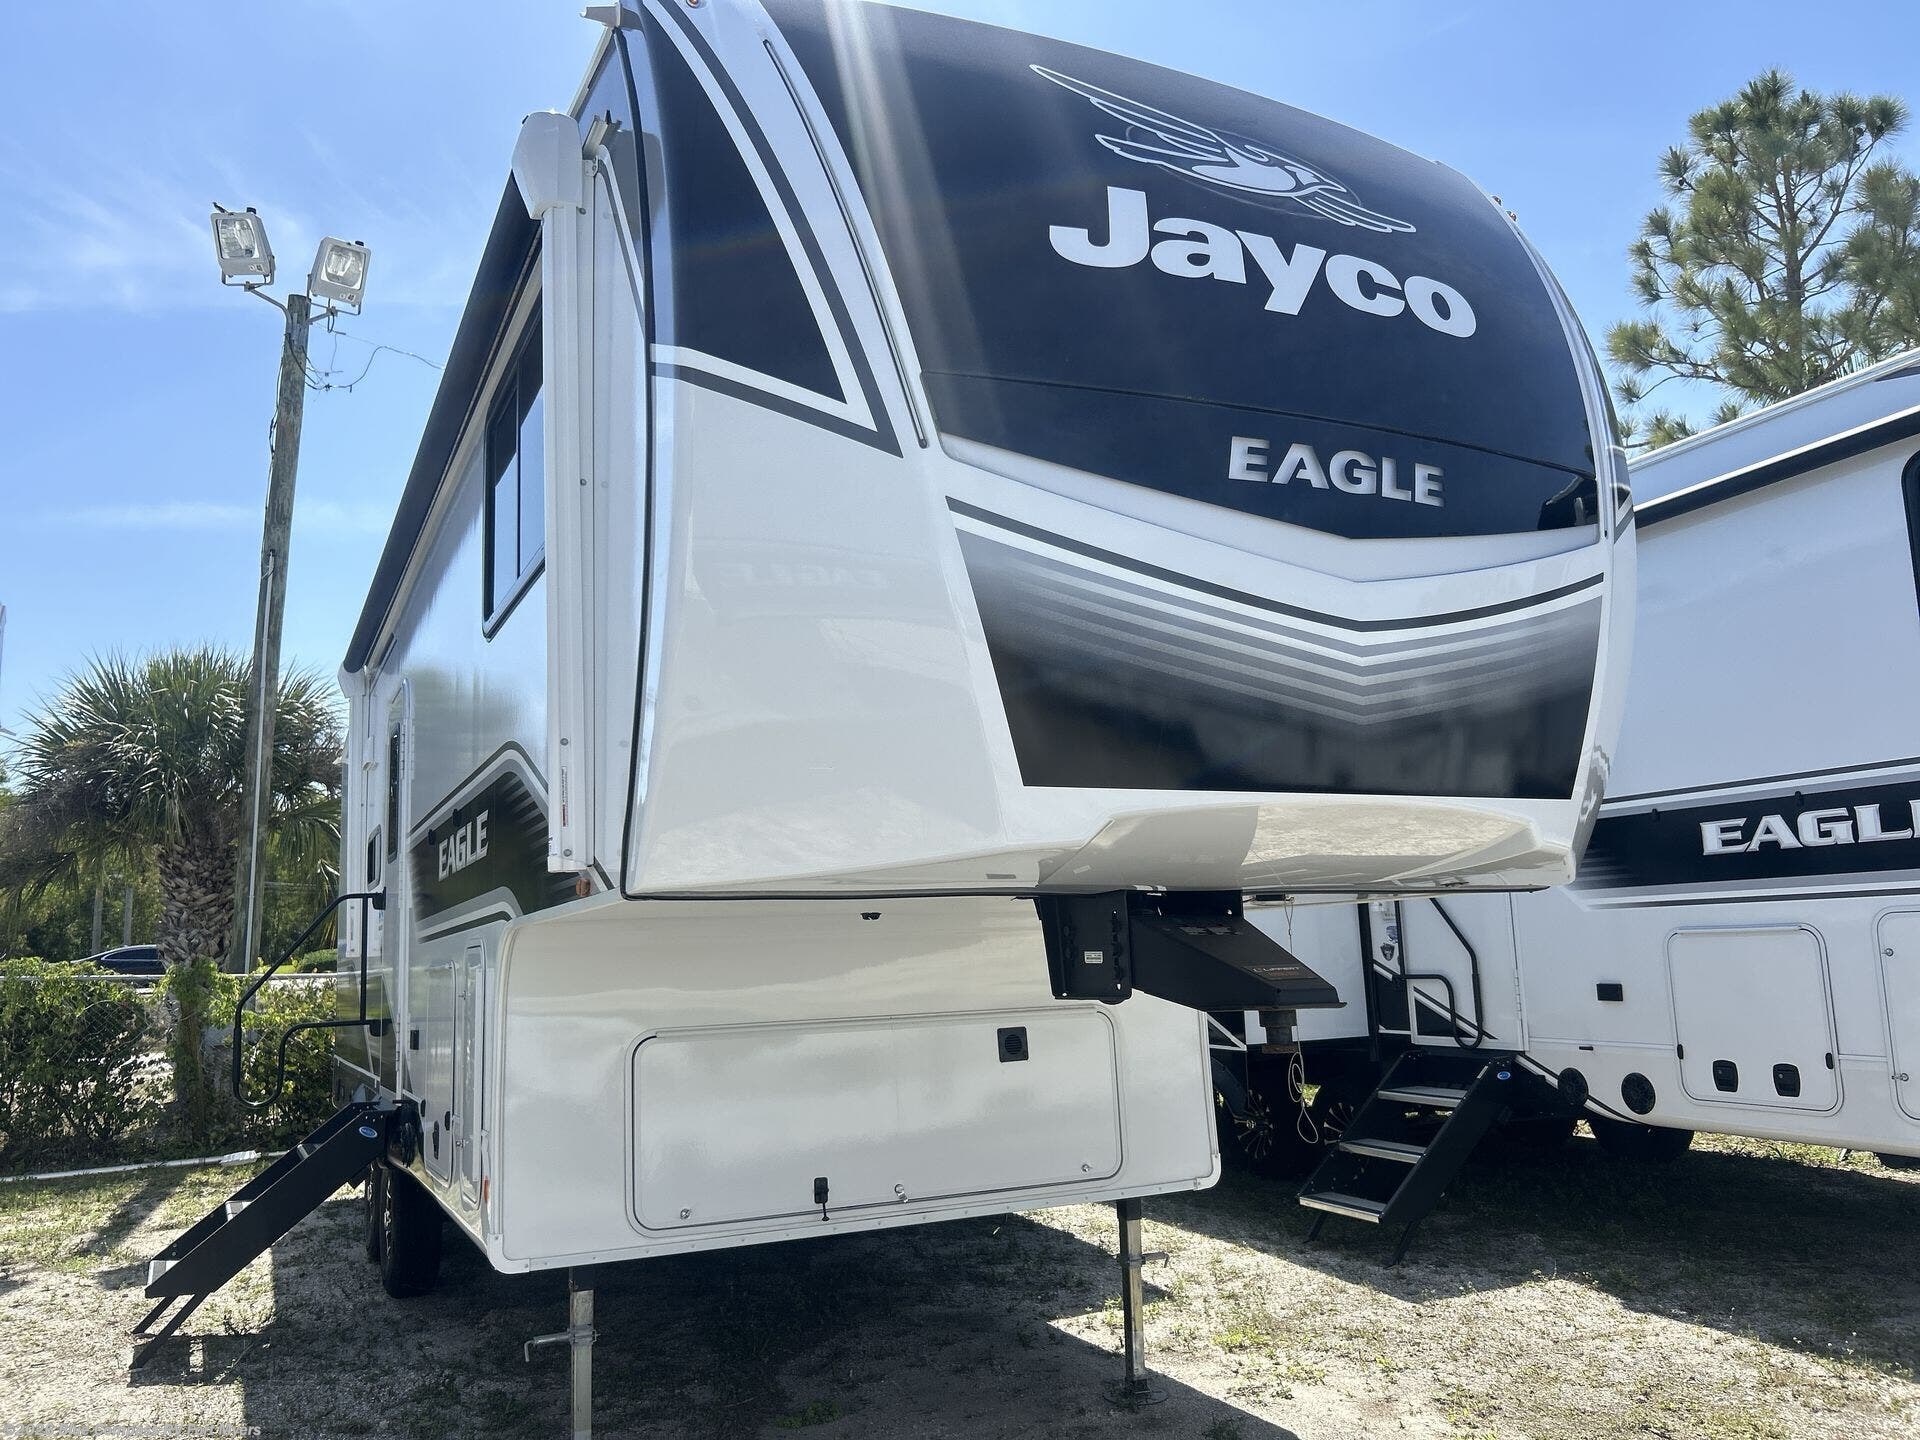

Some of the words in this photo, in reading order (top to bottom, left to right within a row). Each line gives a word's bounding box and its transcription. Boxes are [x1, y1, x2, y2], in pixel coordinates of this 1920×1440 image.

[1049, 186, 1477, 338] Jayco
[1228, 435, 1446, 507] EAGLE
[439, 809, 489, 882] EAGLE
[1700, 799, 1920, 856] EAGL
